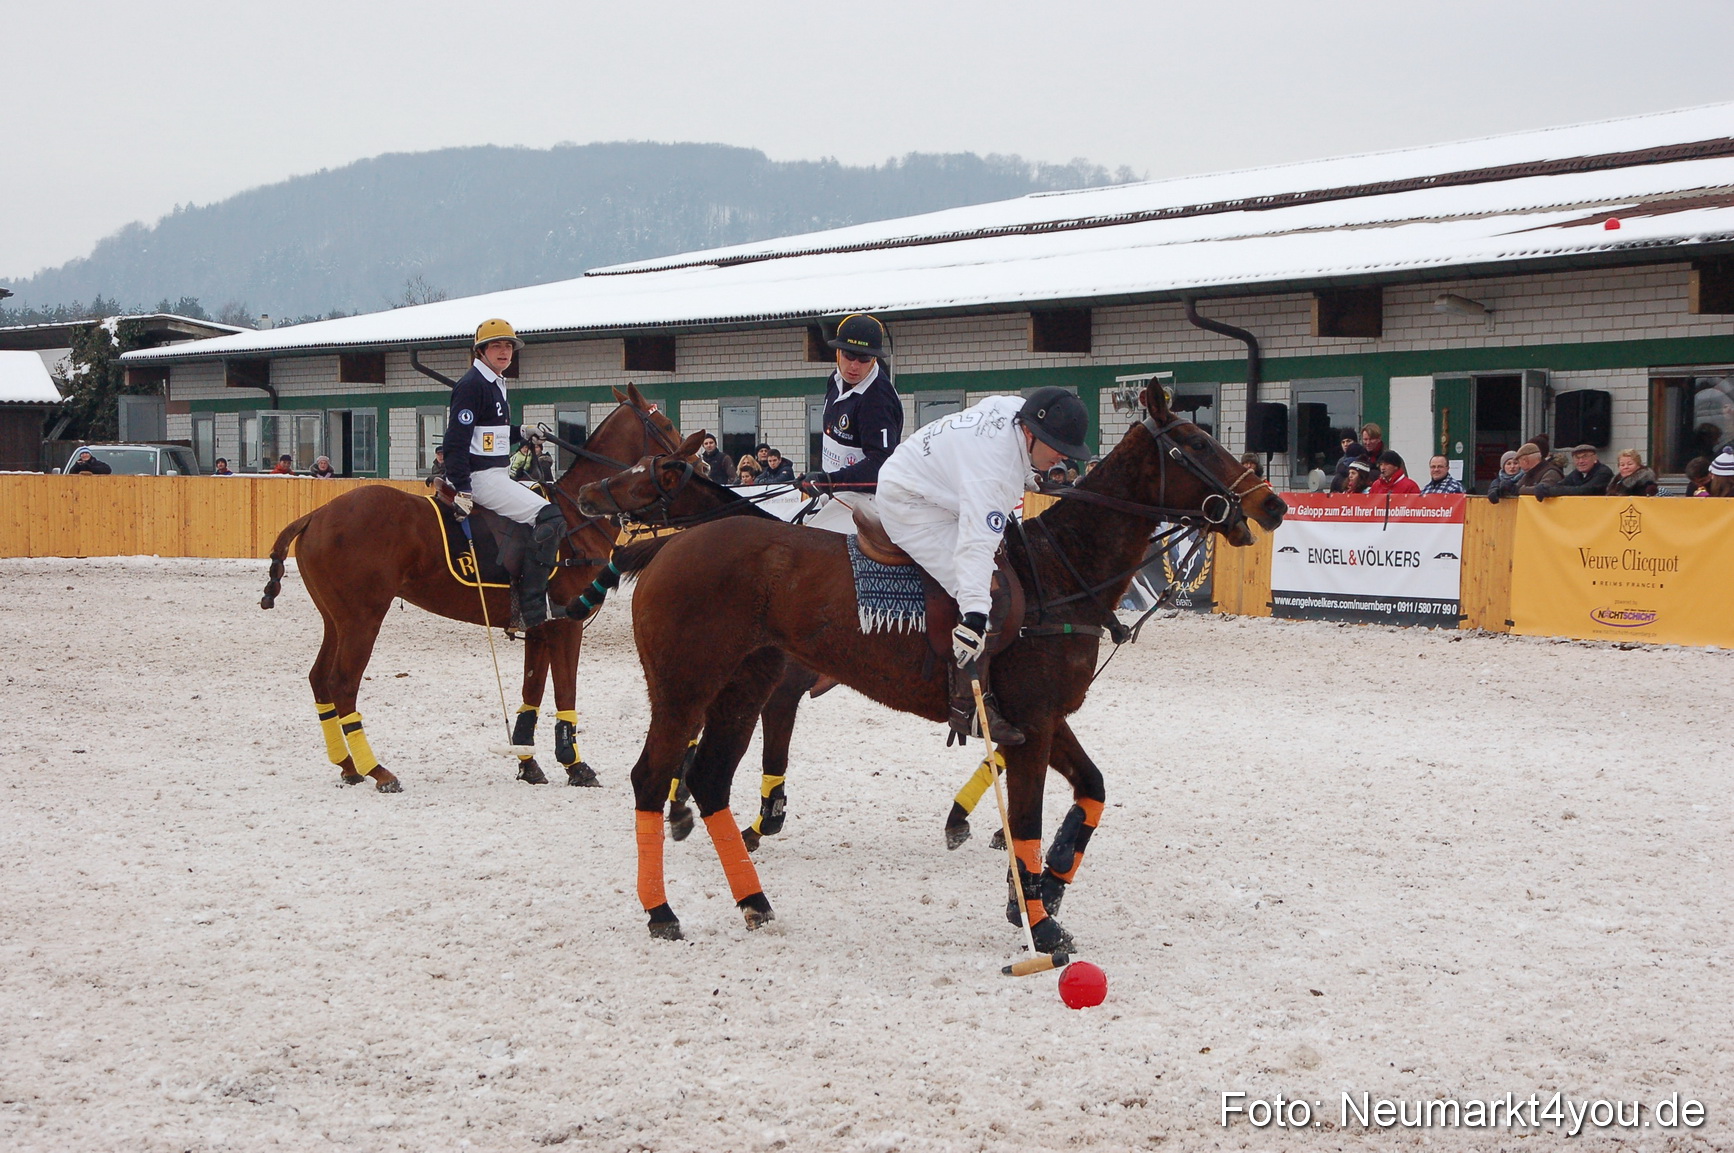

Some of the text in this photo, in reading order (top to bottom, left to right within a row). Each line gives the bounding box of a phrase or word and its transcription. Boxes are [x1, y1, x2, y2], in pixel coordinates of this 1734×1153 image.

[495, 401, 503, 417] 2
[880, 428, 888, 448] 1
[922, 431, 932, 457] TEAM
[1297, 504, 1323, 518] Galopp
[1324, 508, 1340, 516] zum
[1340, 505, 1354, 517] Ziel
[1354, 506, 1373, 517] Ihrer
[456, 556, 475, 576] R
[1578, 547, 1679, 577] Veuve Clicquot
[1175, 598, 1193, 606] EVENTS
[1397, 601, 1413, 613] 0911
[1418, 602, 1432, 614] 580
[1432, 603, 1442, 614] 77
[1442, 603, 1452, 615] 99
